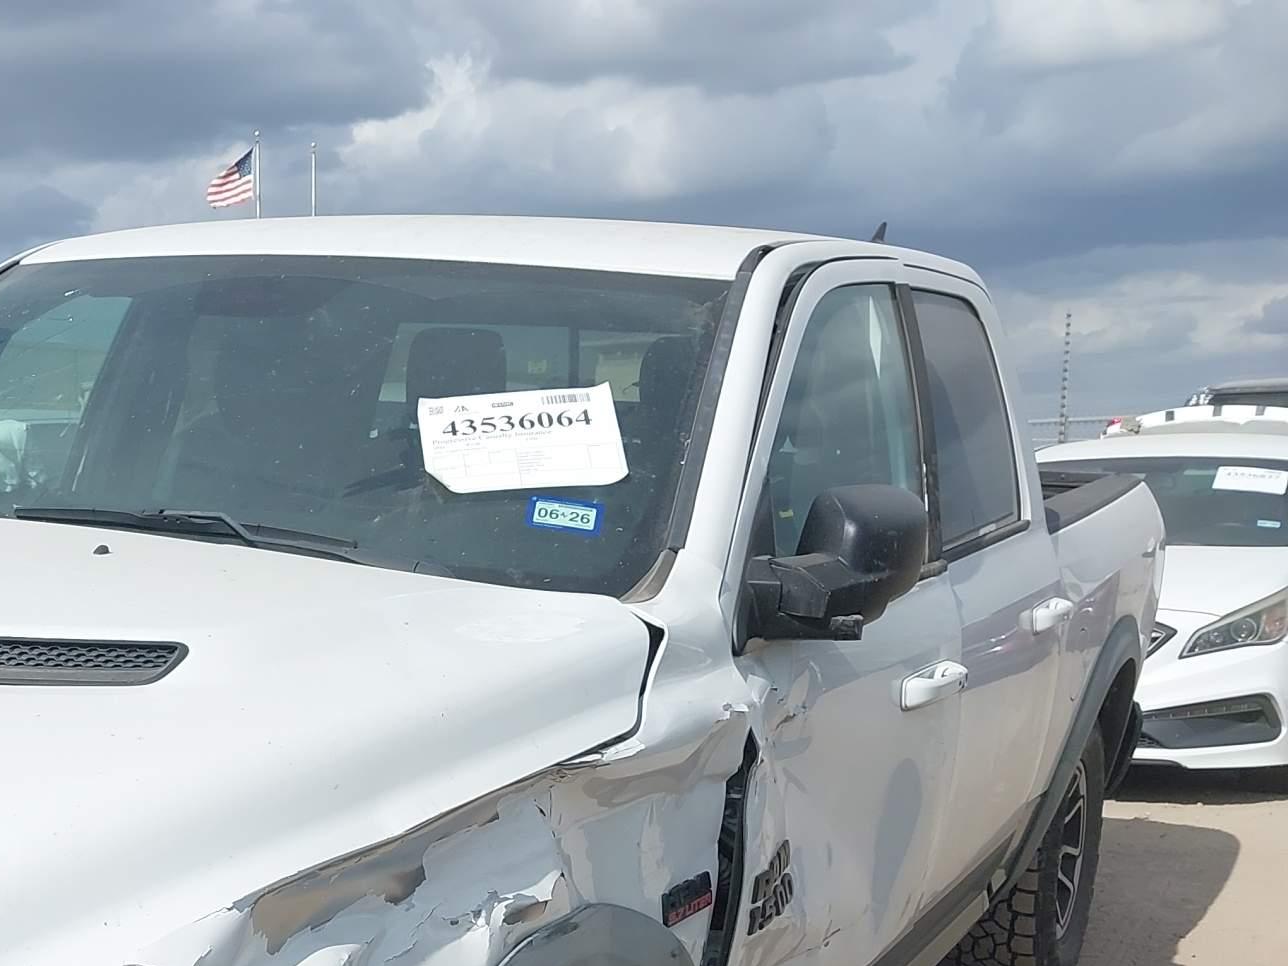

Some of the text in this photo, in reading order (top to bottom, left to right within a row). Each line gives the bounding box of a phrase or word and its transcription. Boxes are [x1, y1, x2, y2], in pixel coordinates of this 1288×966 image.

[442, 408, 593, 437] 43536064
[751, 839, 791, 904] RAM
[747, 872, 794, 936] 1500
